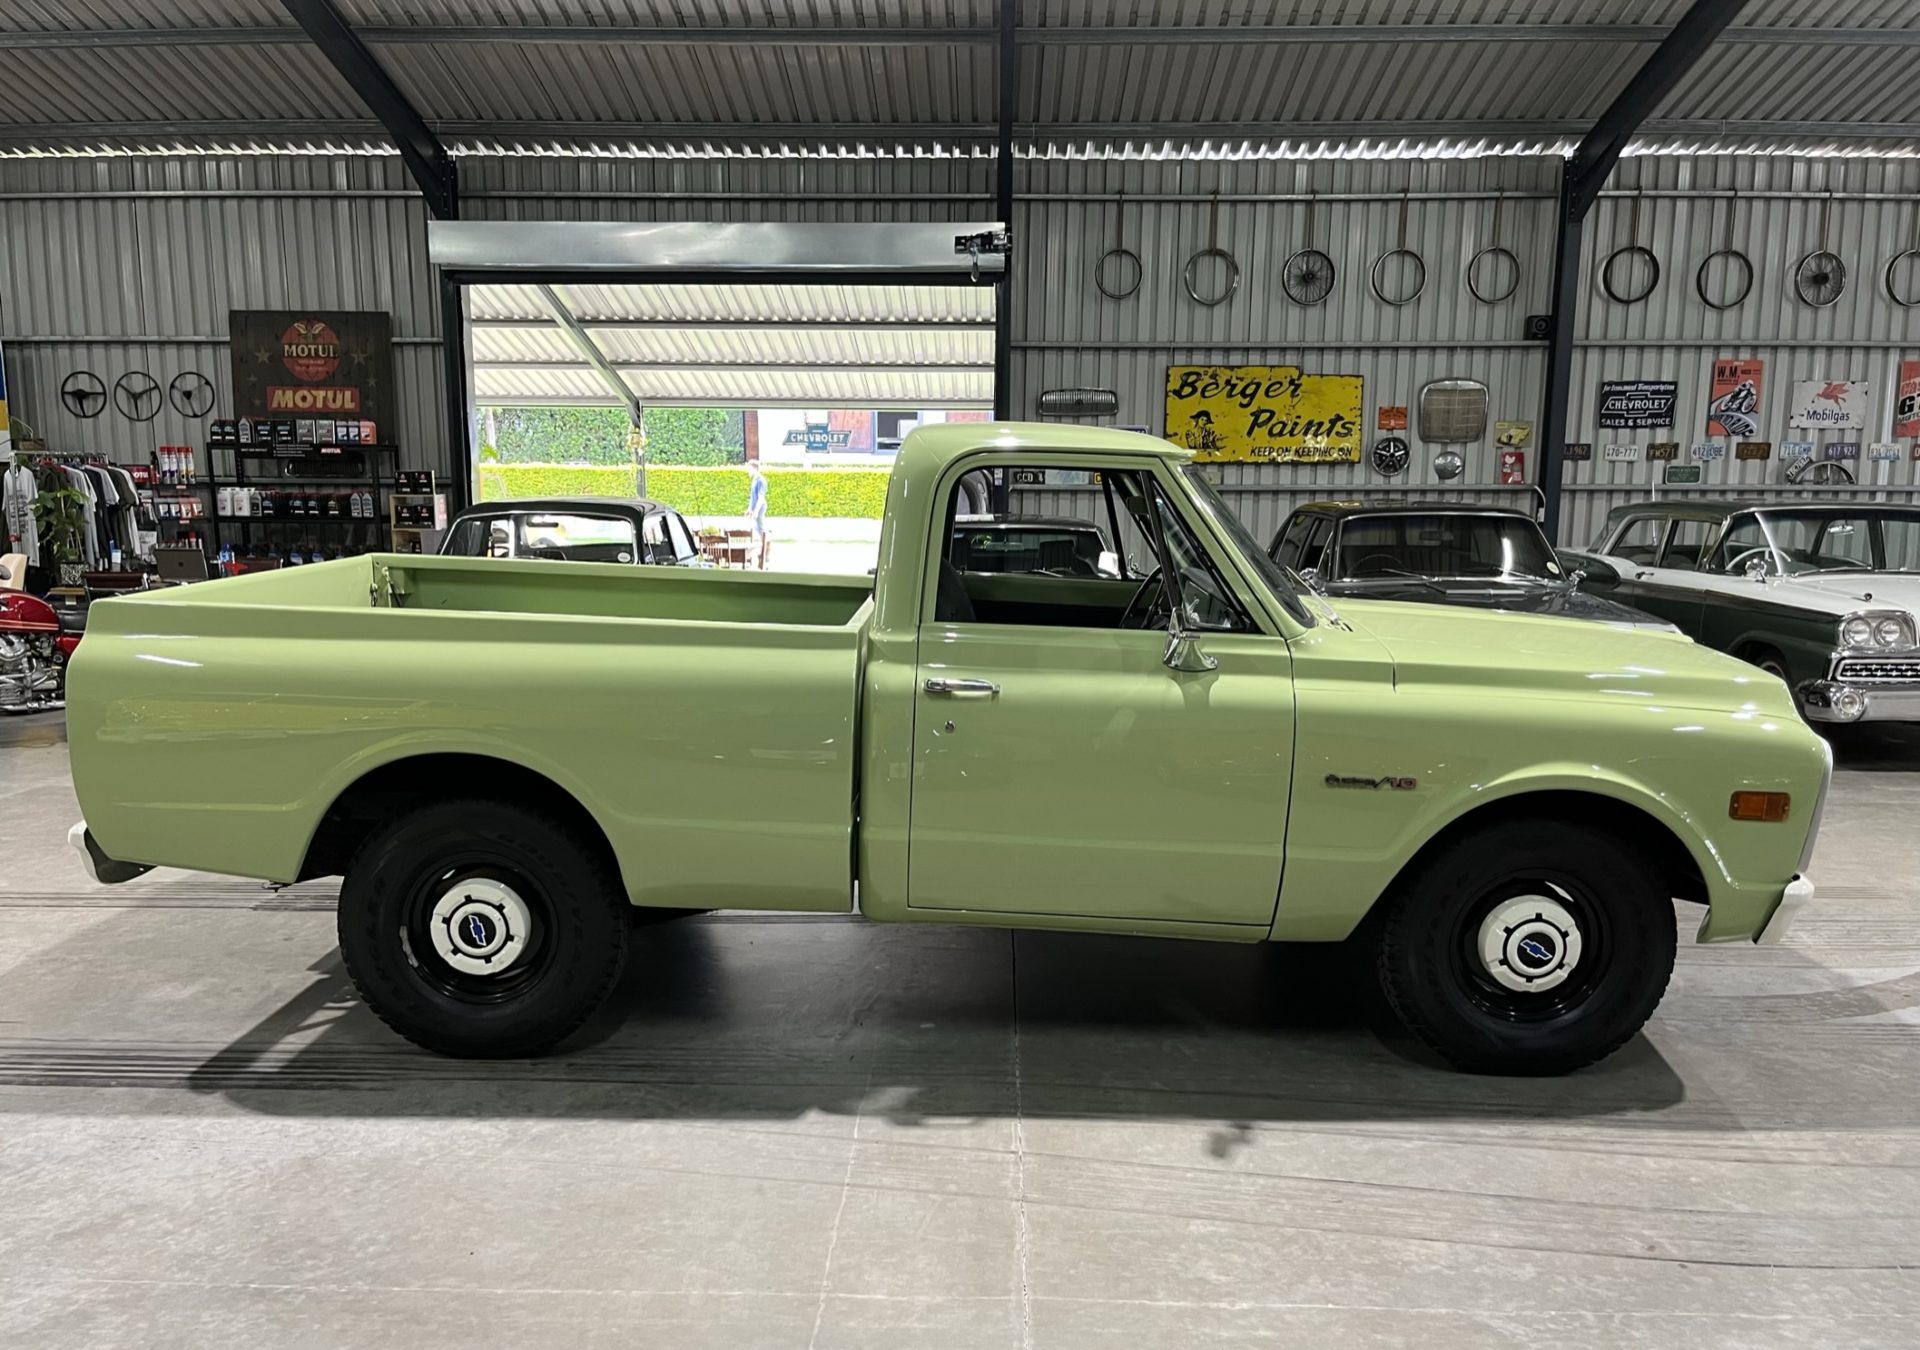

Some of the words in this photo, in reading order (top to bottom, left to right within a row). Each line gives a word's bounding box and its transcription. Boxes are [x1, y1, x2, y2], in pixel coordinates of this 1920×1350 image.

[284, 344, 338, 357] MOTUL
[1174, 370, 1302, 409] Berger
[271, 390, 355, 409] MOTUL
[1608, 400, 1667, 410] CHEVROLET
[1246, 408, 1355, 438] Paints
[1806, 410, 1850, 424] Mobilgas
[790, 433, 845, 442] CHEVROLET
[1250, 446, 1275, 456] KEEP
[1277, 446, 1291, 456] ON
